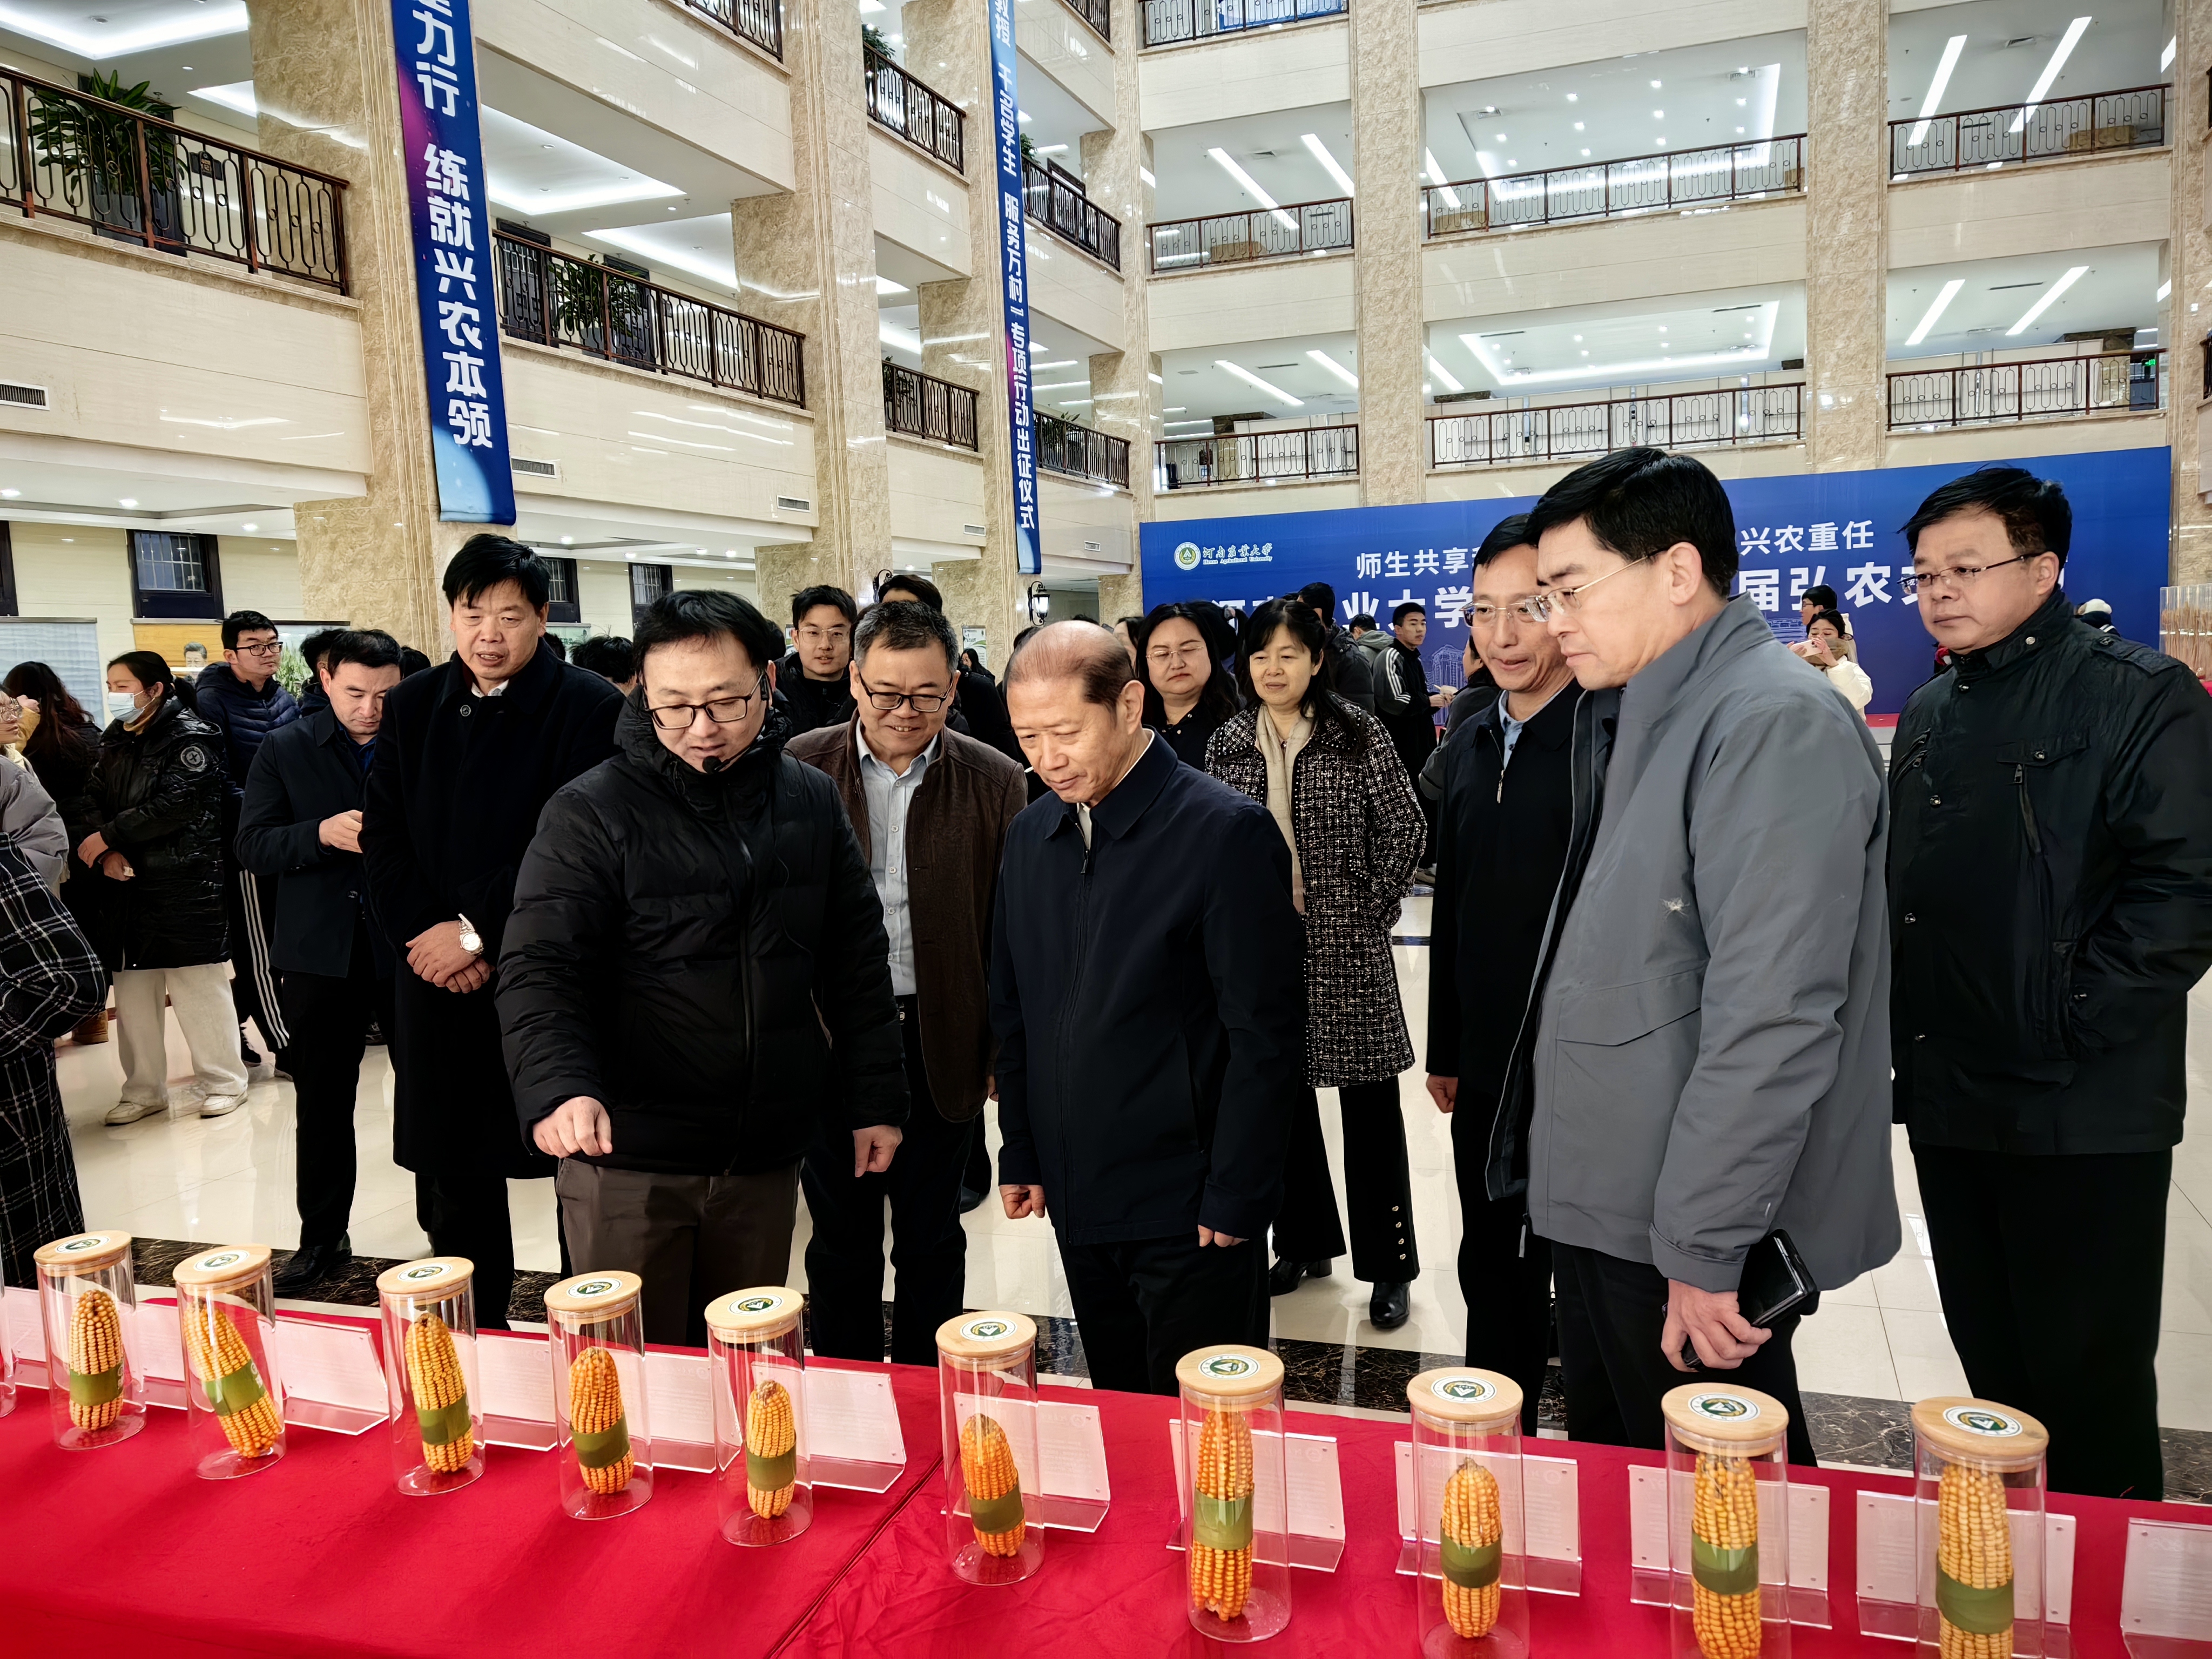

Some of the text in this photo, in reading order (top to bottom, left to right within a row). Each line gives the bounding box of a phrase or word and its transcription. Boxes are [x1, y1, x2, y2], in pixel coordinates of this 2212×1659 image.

[998, 62, 1017, 177] 千名学生
[424, 143, 493, 449] 练就兴农本领
[1357, 520, 1874, 579] 师生共享 兴农重任
